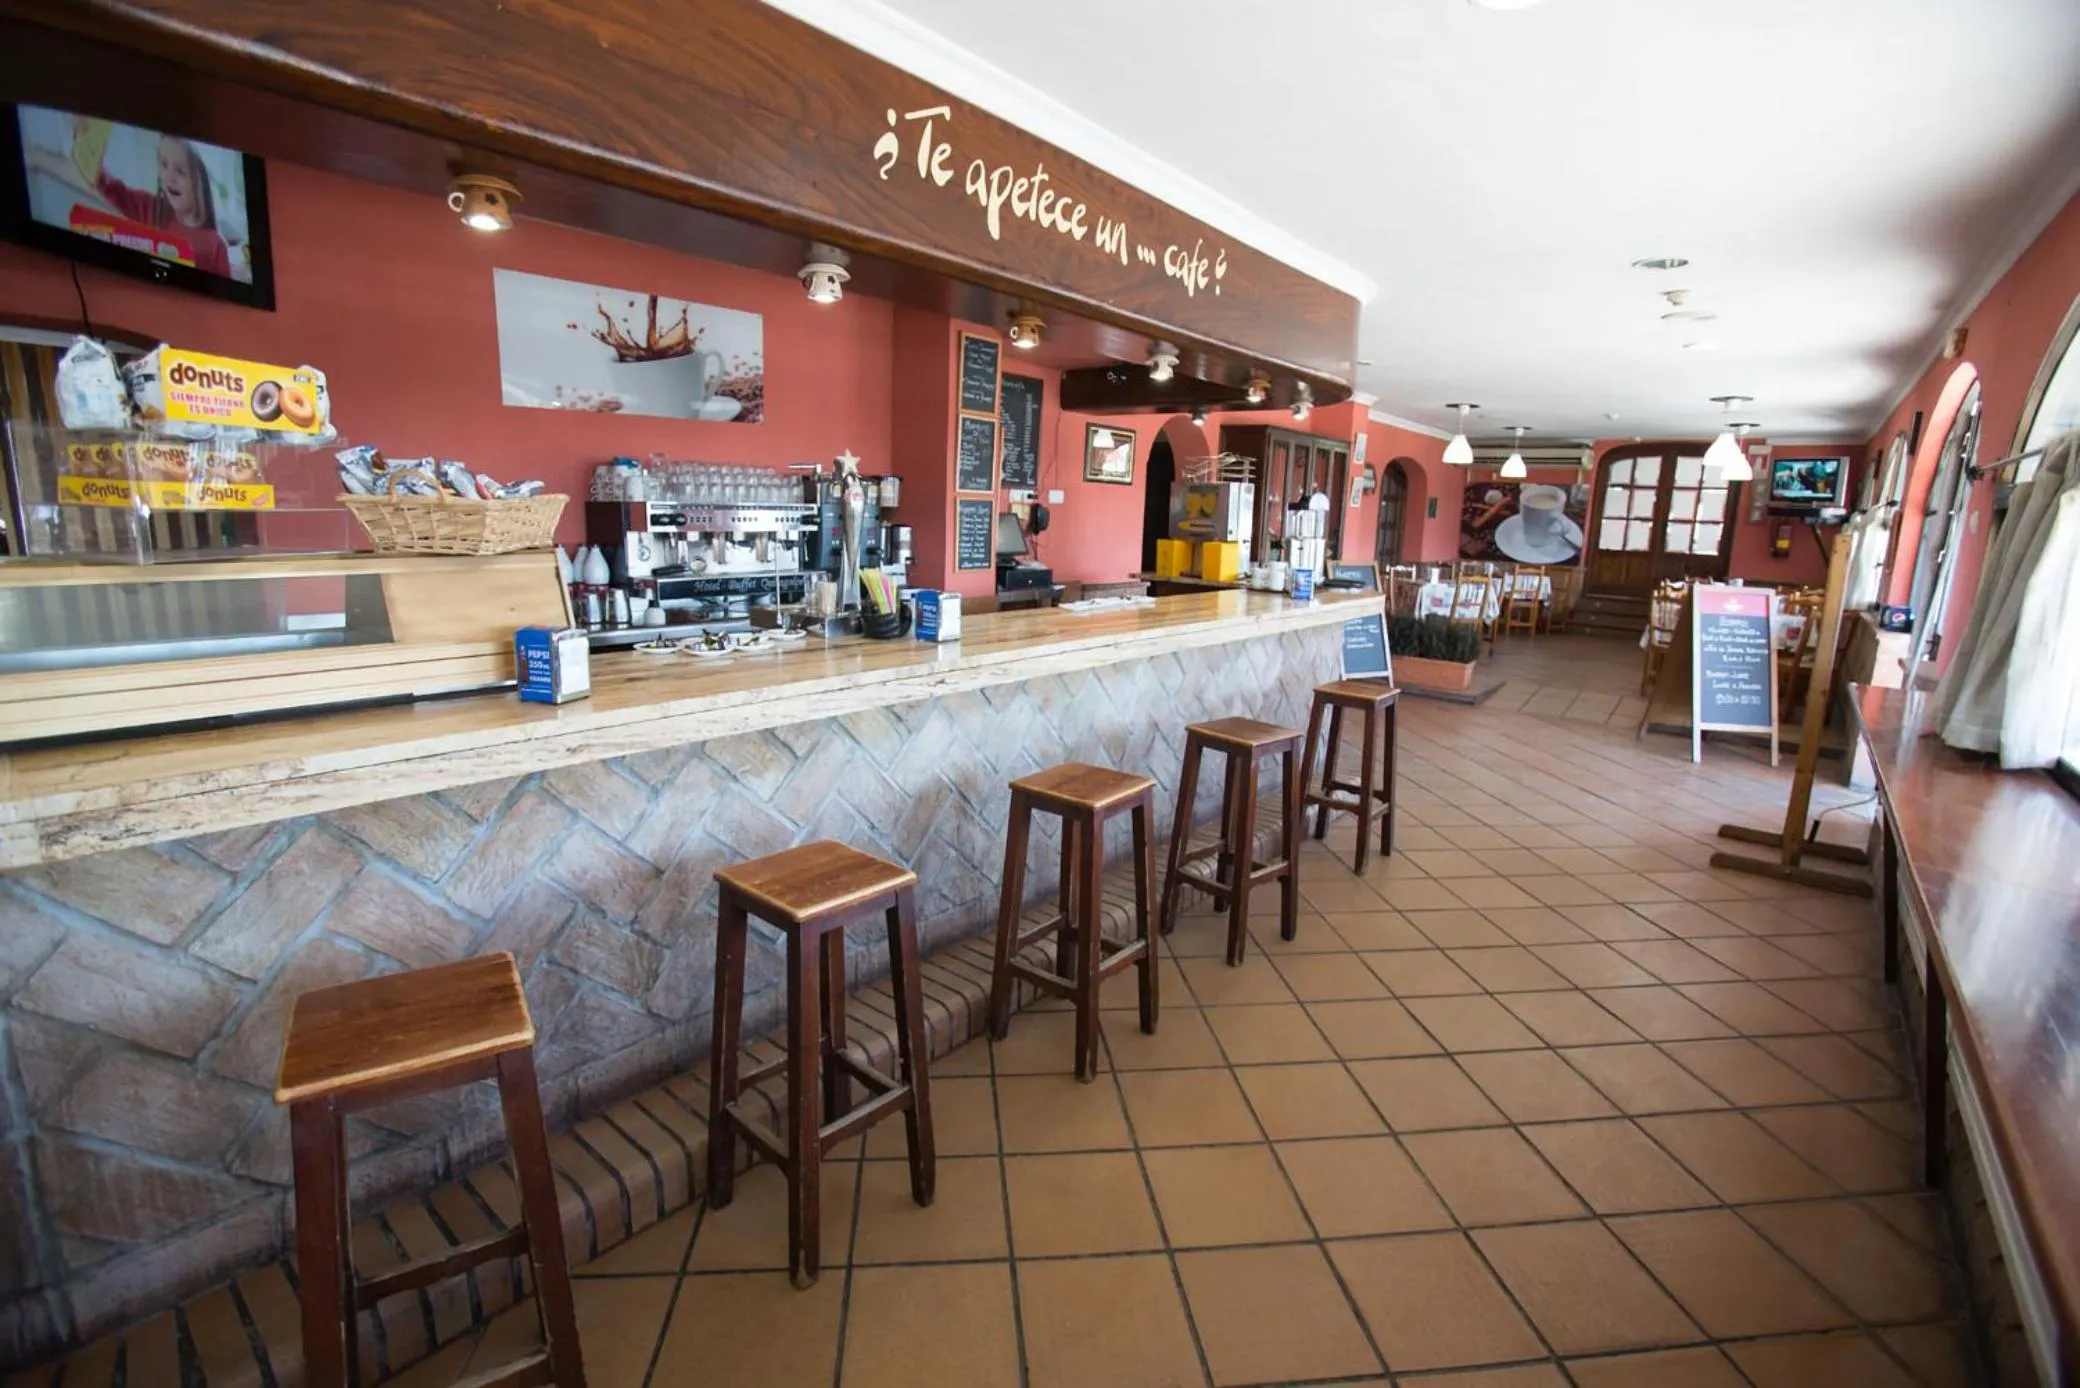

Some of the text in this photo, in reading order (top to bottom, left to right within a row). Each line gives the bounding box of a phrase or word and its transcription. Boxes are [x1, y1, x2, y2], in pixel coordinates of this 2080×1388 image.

[965, 158, 1089, 241] apetece
[1095, 215, 1129, 267] un
[169, 362, 245, 393] donuts
